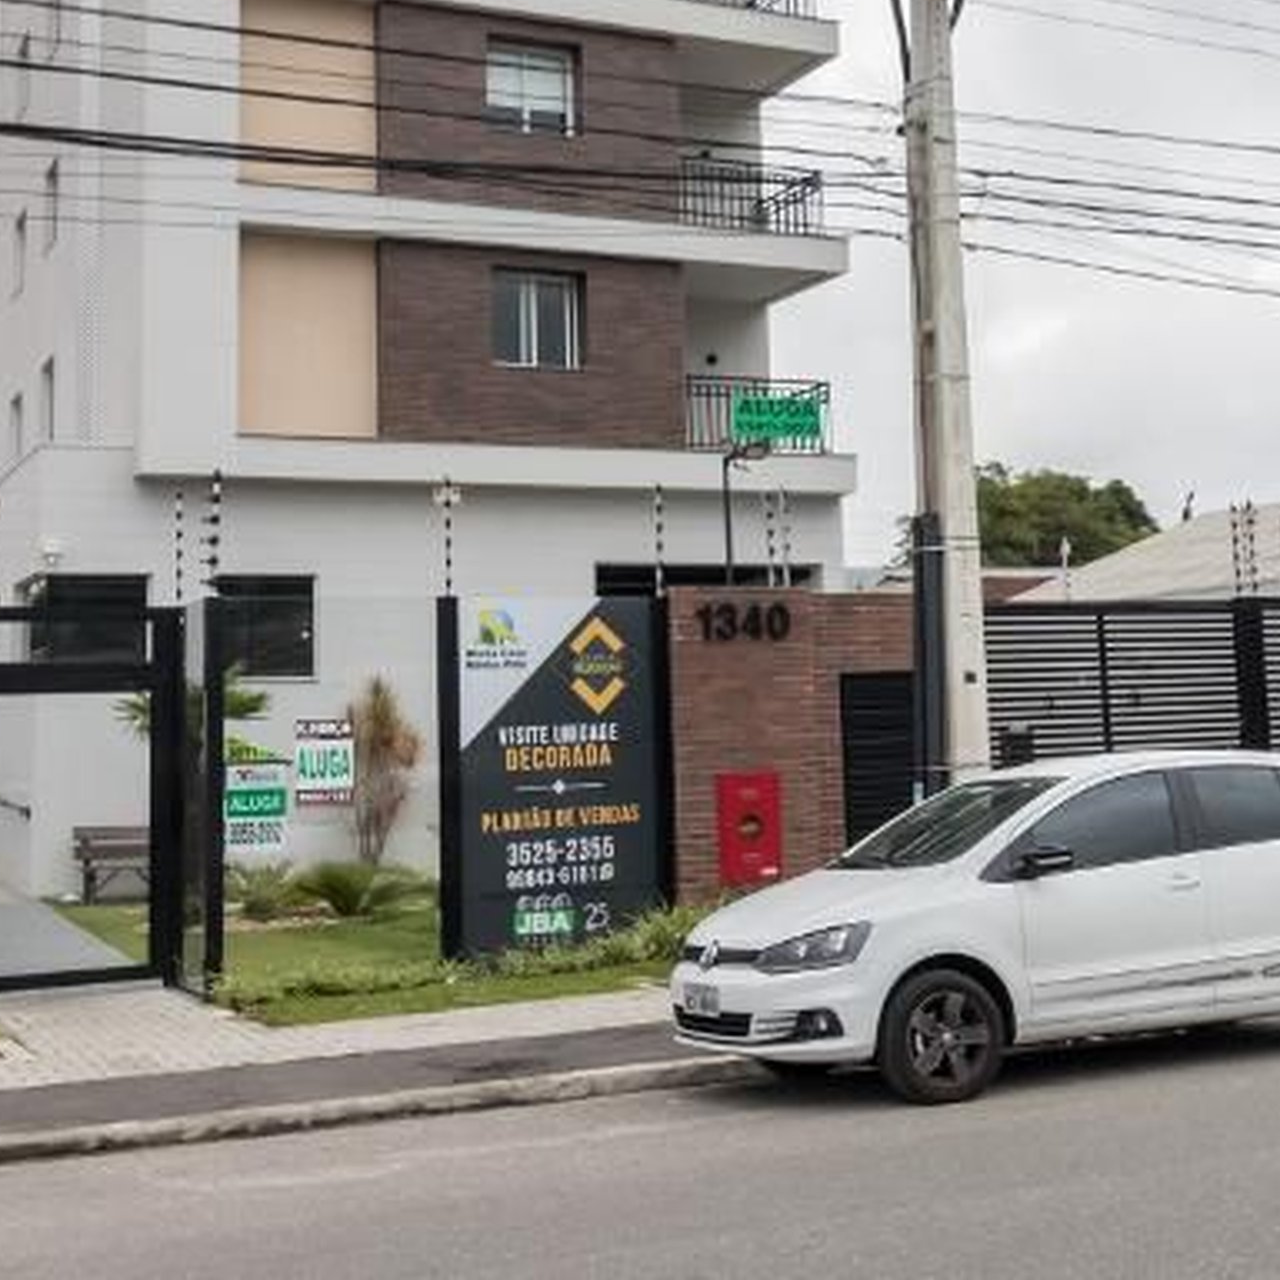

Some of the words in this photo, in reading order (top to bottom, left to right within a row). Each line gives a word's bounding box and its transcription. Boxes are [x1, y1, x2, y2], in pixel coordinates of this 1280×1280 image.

[739, 398, 816, 419] ALUGA
[695, 603, 791, 641] 1340
[498, 725, 549, 746] VISITE
[297, 746, 351, 780] ALUGA
[505, 743, 612, 772] DECORADA
[578, 802, 642, 825] VENDAS
[513, 910, 574, 935] JBA
